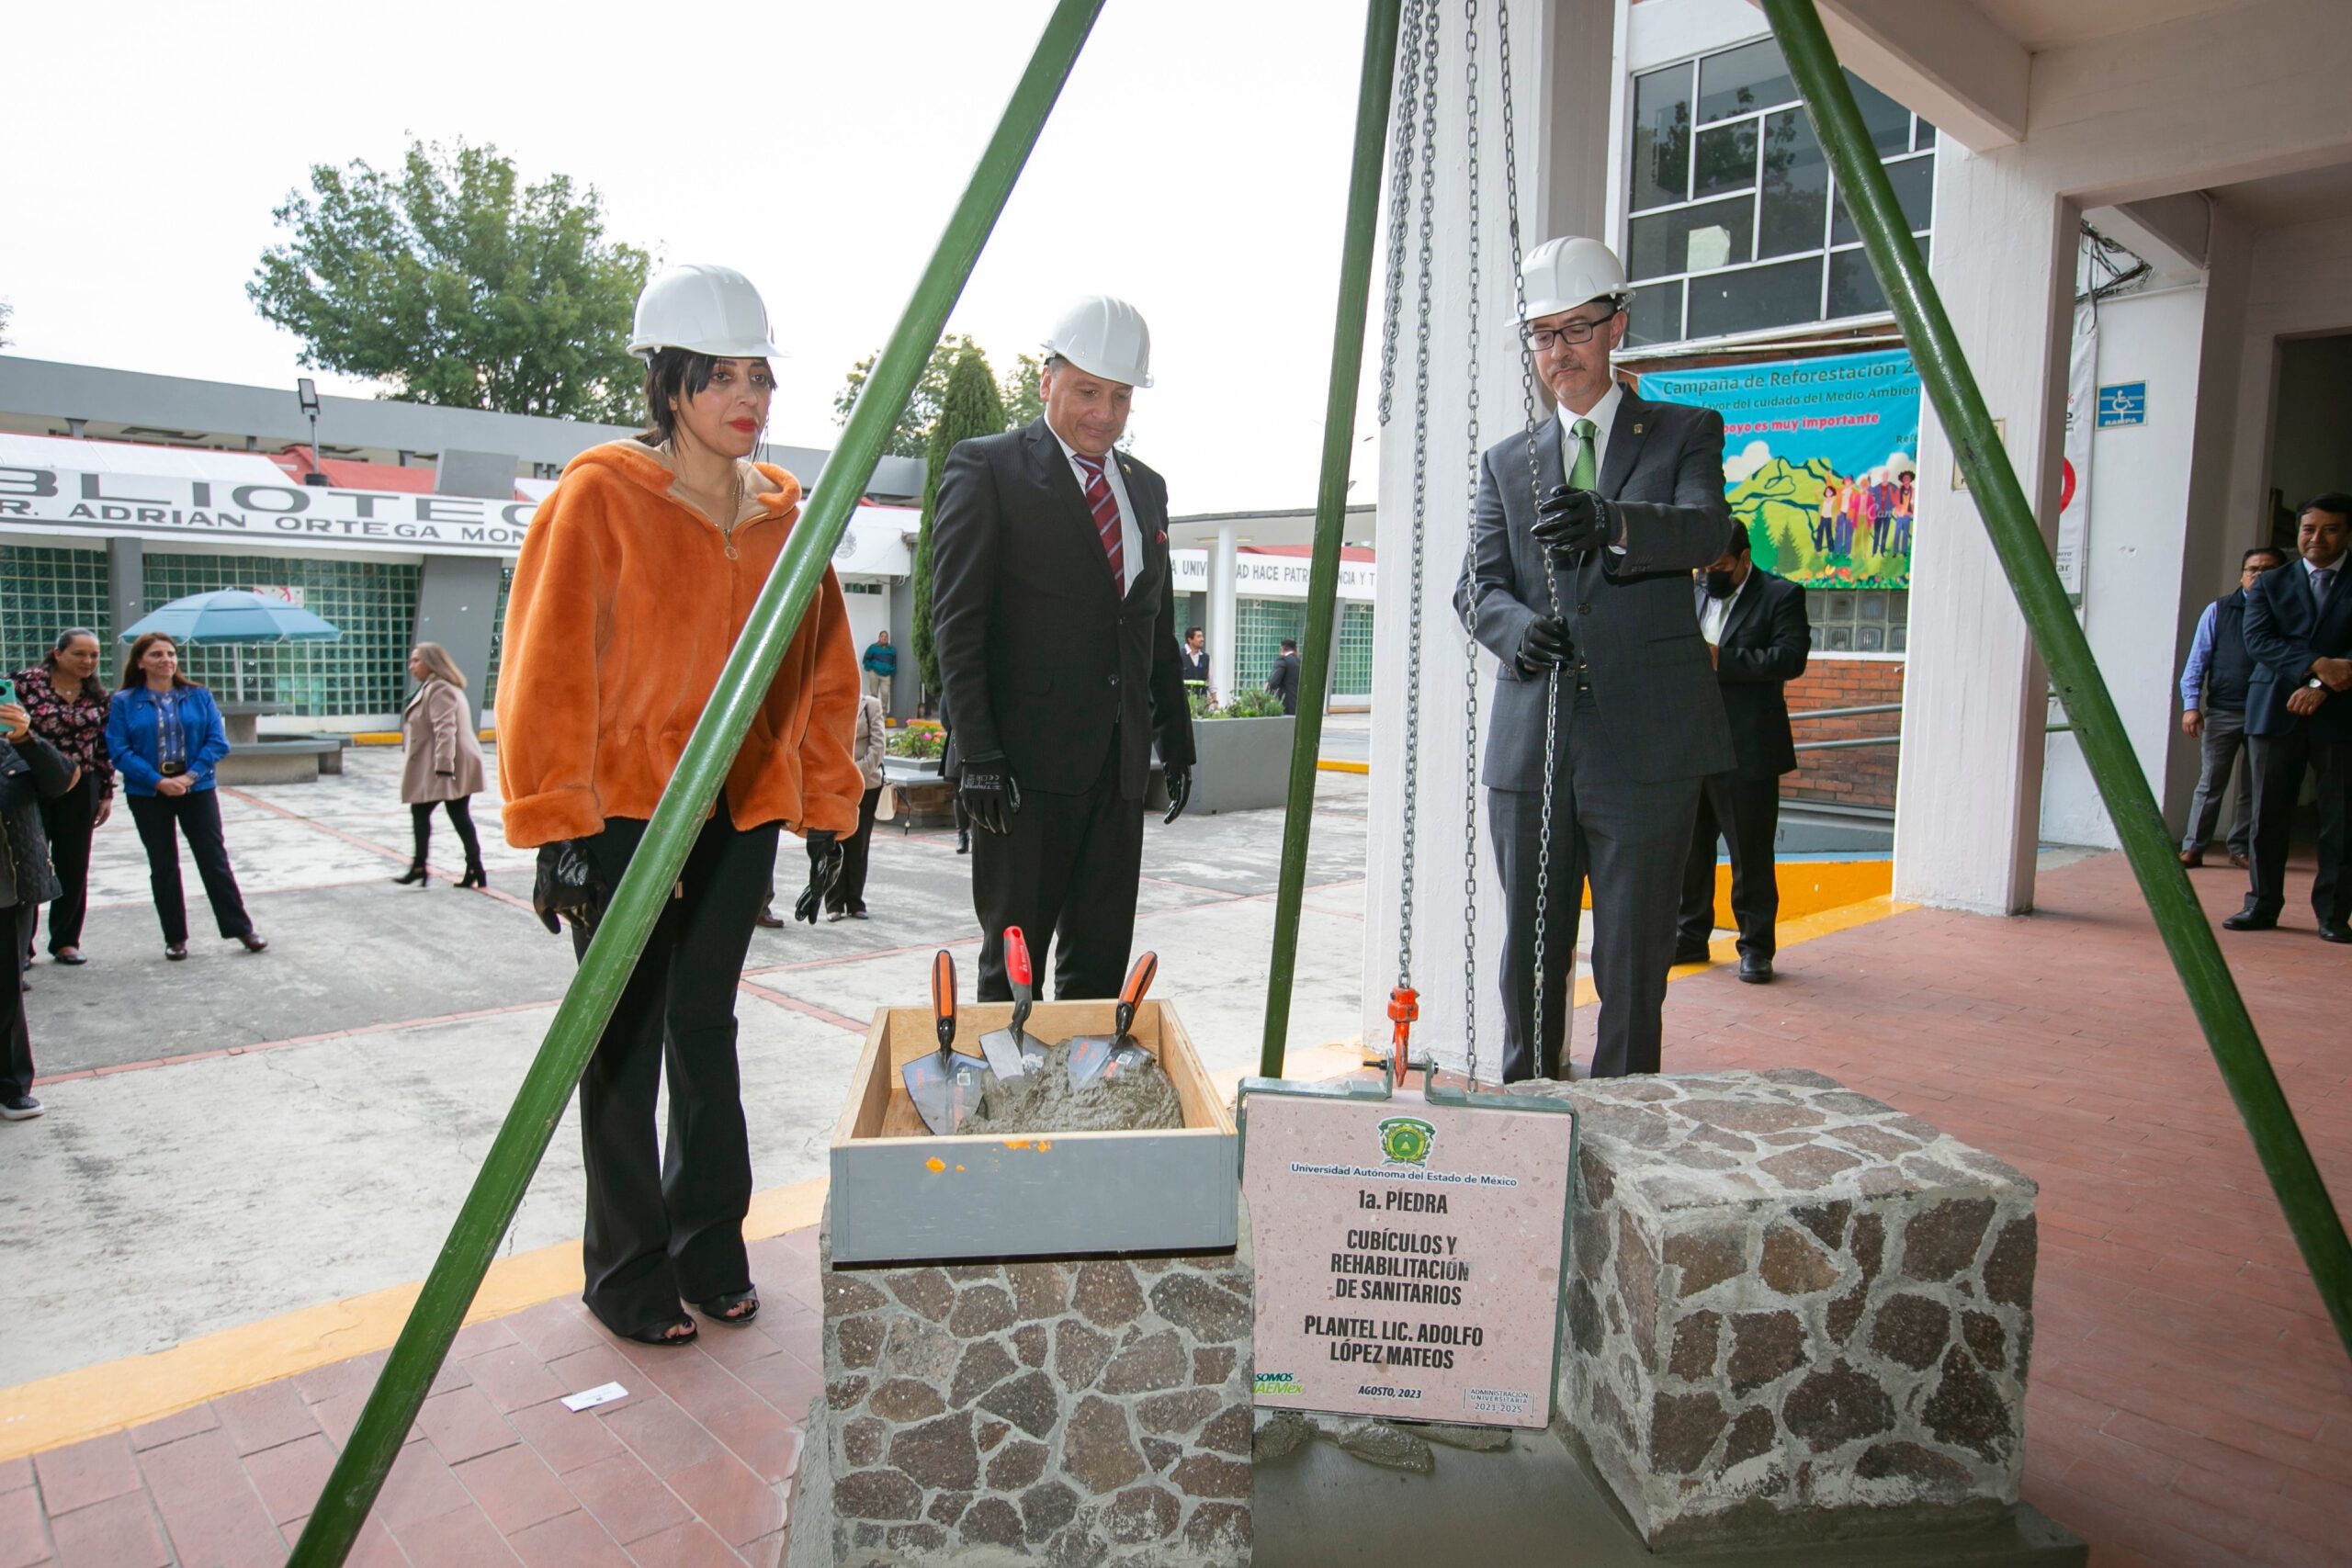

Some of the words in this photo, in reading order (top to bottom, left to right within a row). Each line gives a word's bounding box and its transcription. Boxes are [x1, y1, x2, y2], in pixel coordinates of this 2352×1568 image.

[1663, 376, 1739, 396] Campaña
[1744, 374, 1765, 389] de
[1770, 360, 1897, 387] Reforestación
[1903, 359, 1914, 374] 2
[1733, 398, 1751, 411] del
[1753, 396, 1800, 409] cuidado
[1804, 392, 1822, 404] del
[1826, 389, 1864, 403] Medio
[1868, 386, 1919, 399] Ambien
[1724, 422, 1752, 435] poyo
[1754, 422, 1768, 432] es
[1771, 419, 1798, 433] muy
[1802, 412, 1879, 429] importante
[2105, 417, 2137, 426] RAMPA
[68, 503, 246, 527] ADRIAN
[275, 516, 441, 539] ORTEGA
[1253, 564, 1279, 581] HACE
[1283, 567, 1309, 583] PATR
[1291, 1162, 1351, 1176] Universidad
[1353, 1167, 1406, 1179] Autónoma
[1408, 1169, 1424, 1180] del
[1427, 1172, 1461, 1183] Estado
[1464, 1174, 1477, 1184] de
[1480, 1176, 1517, 1186] México
[1358, 1190, 1381, 1210] 1a.
[1385, 1190, 1448, 1213] PIEDRA
[1347, 1228, 1442, 1255] CUBÍCULOS
[1447, 1236, 1457, 1256] Y
[1331, 1253, 1470, 1281] REHABILITACIÓN
[1336, 1278, 1358, 1298] DE
[1361, 1280, 1462, 1305] SANITARIOS
[1304, 1315, 1378, 1339] PLANTEL
[1382, 1321, 1413, 1342] LIC.
[1417, 1323, 1483, 1347] ADOLFO
[1330, 1338, 1384, 1364] LÓPEZ
[1386, 1346, 1453, 1369] MATEOS
[1255, 1372, 1295, 1382] SOMOS
[1358, 1385, 1396, 1398] AGOSTO,
[1397, 1388, 1421, 1399] 2023
[1470, 1394, 1528, 1404] UNIVERSITARIA
[1475, 1403, 1522, 1414] 2021-2025
